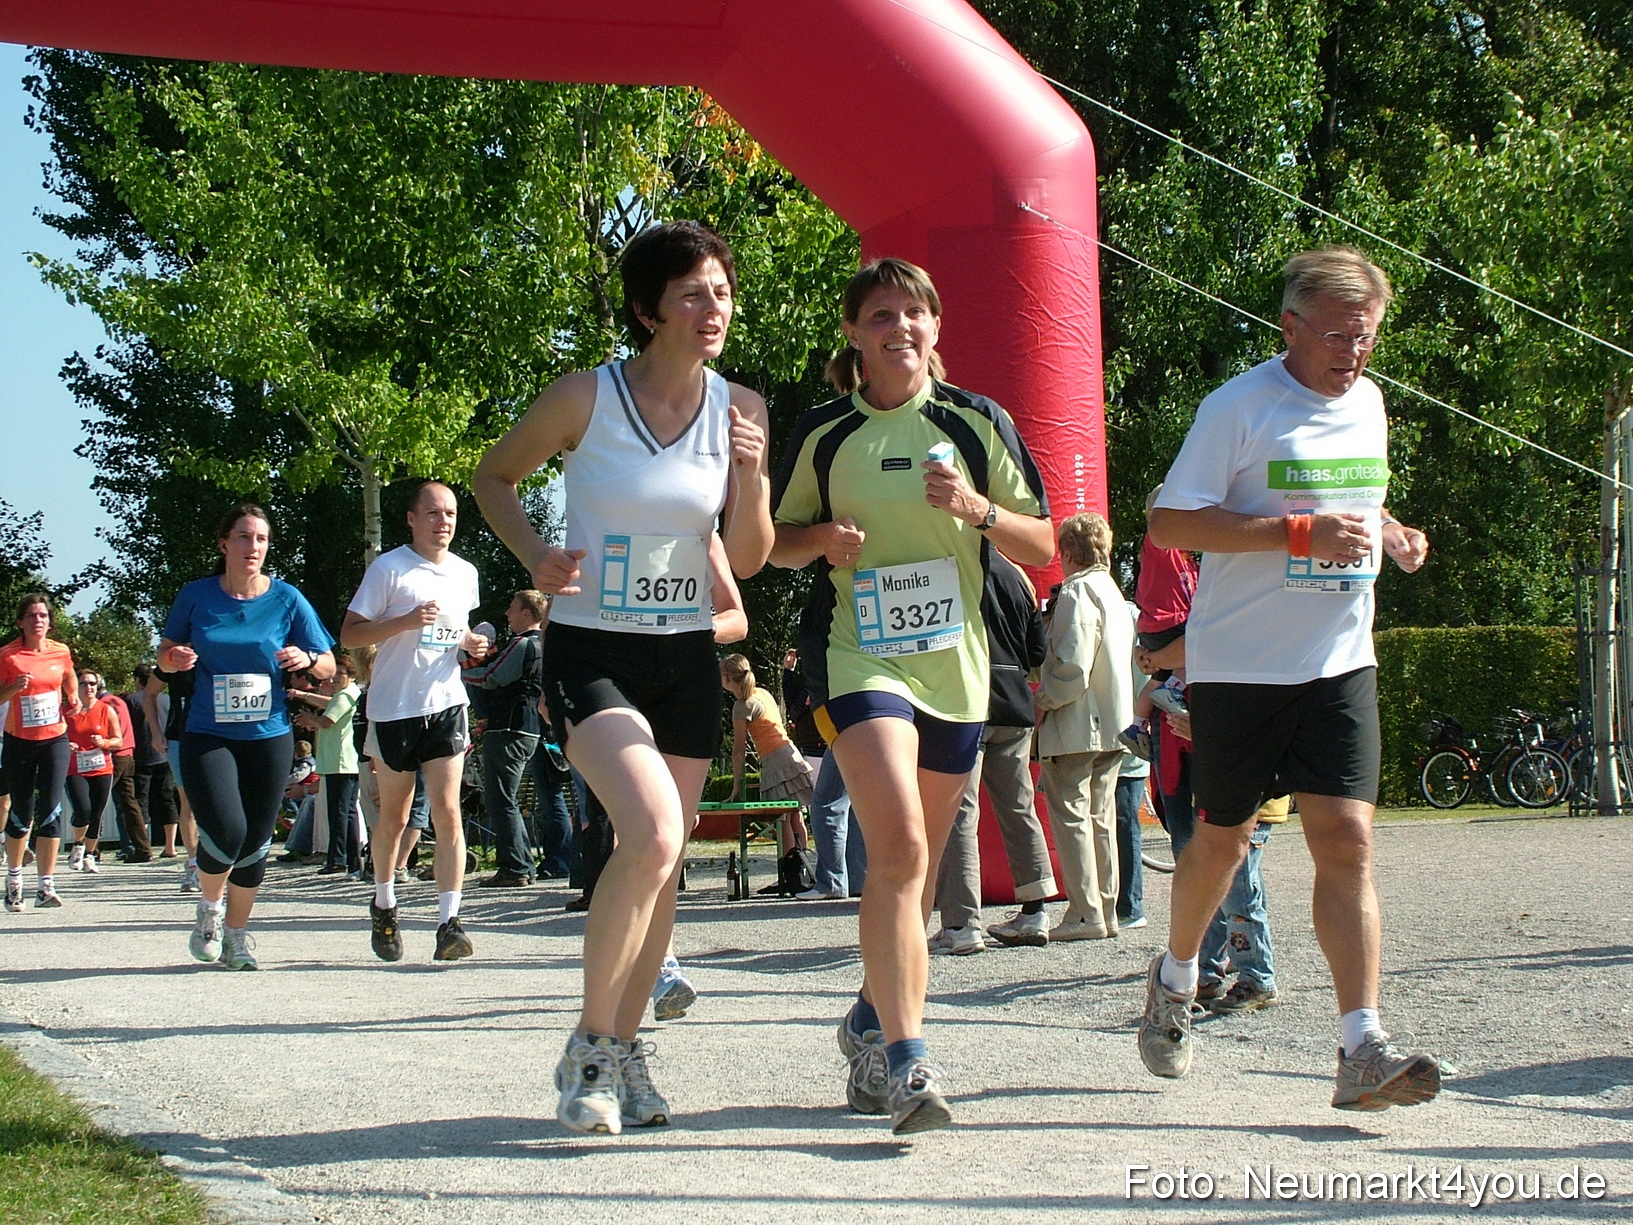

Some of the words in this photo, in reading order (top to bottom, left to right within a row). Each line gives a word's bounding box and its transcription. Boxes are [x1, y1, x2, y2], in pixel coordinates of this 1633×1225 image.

[1074, 453, 1085, 483] 1929
[1284, 492, 1347, 501] Kommunikation
[1349, 490, 1365, 499] und
[881, 572, 930, 593] Monika
[1286, 580, 1327, 588] BOCK
[635, 577, 697, 602] 3670
[601, 611, 643, 622] BOCK
[860, 605, 867, 617] D
[889, 598, 954, 631] 3327
[436, 628, 463, 641] 3747
[229, 679, 254, 688] Bianca
[231, 695, 267, 709] 3107
